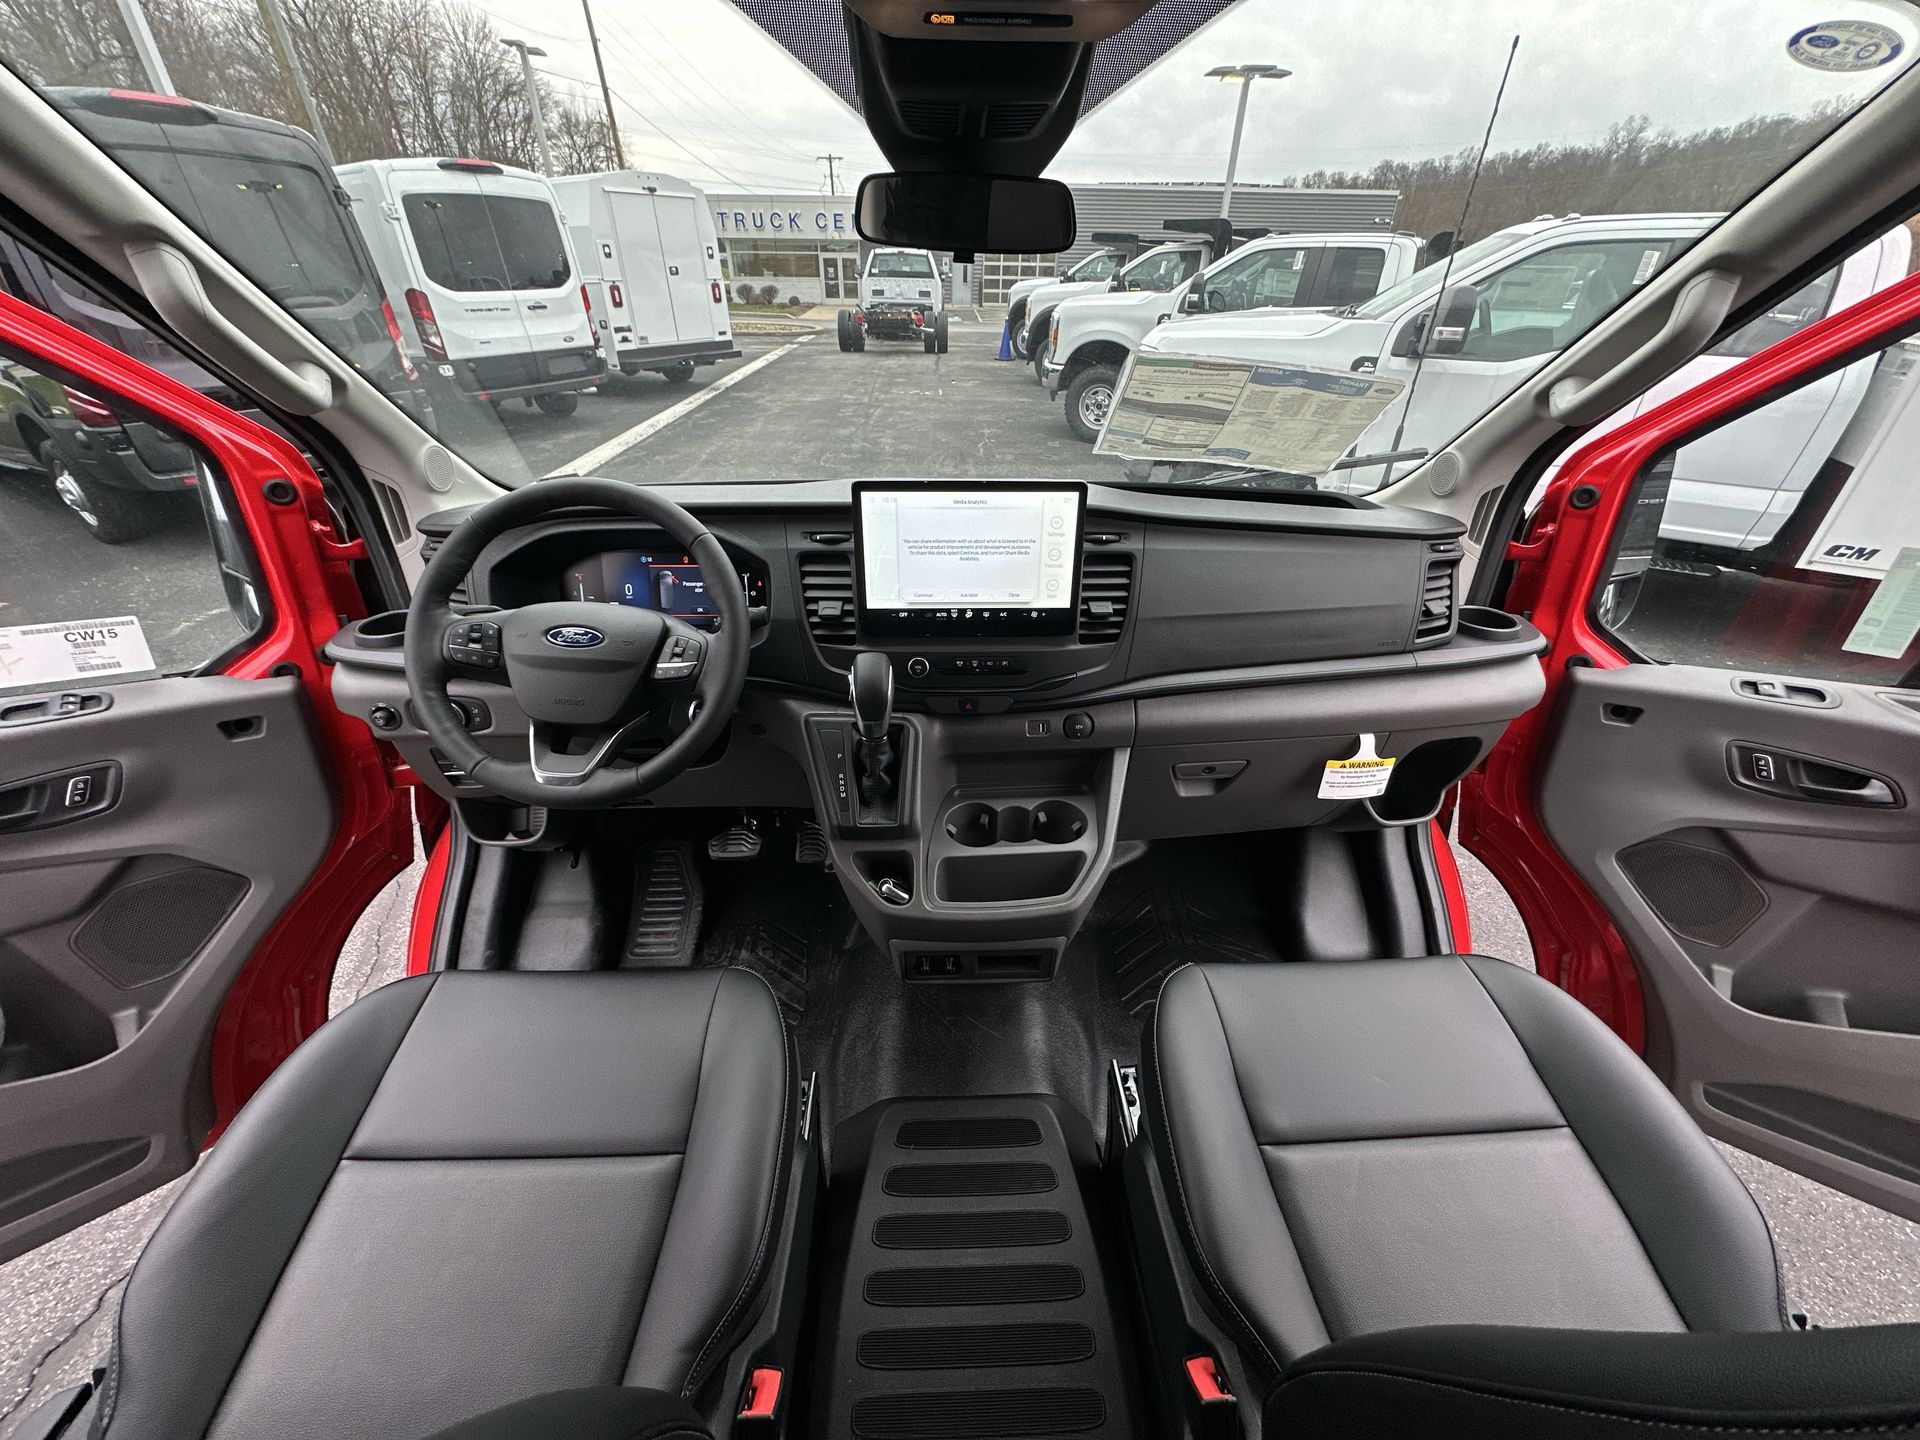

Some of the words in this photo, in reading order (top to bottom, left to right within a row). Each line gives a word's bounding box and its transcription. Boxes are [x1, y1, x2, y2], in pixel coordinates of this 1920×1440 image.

[717, 212, 801, 230] TRUCK
[815, 212, 856, 230] CE
[1823, 545, 1881, 561] CM
[625, 584, 633, 595] 0
[64, 628, 118, 643] CW15
[557, 630, 593, 643] Ford
[1349, 760, 1385, 769] WARNING
